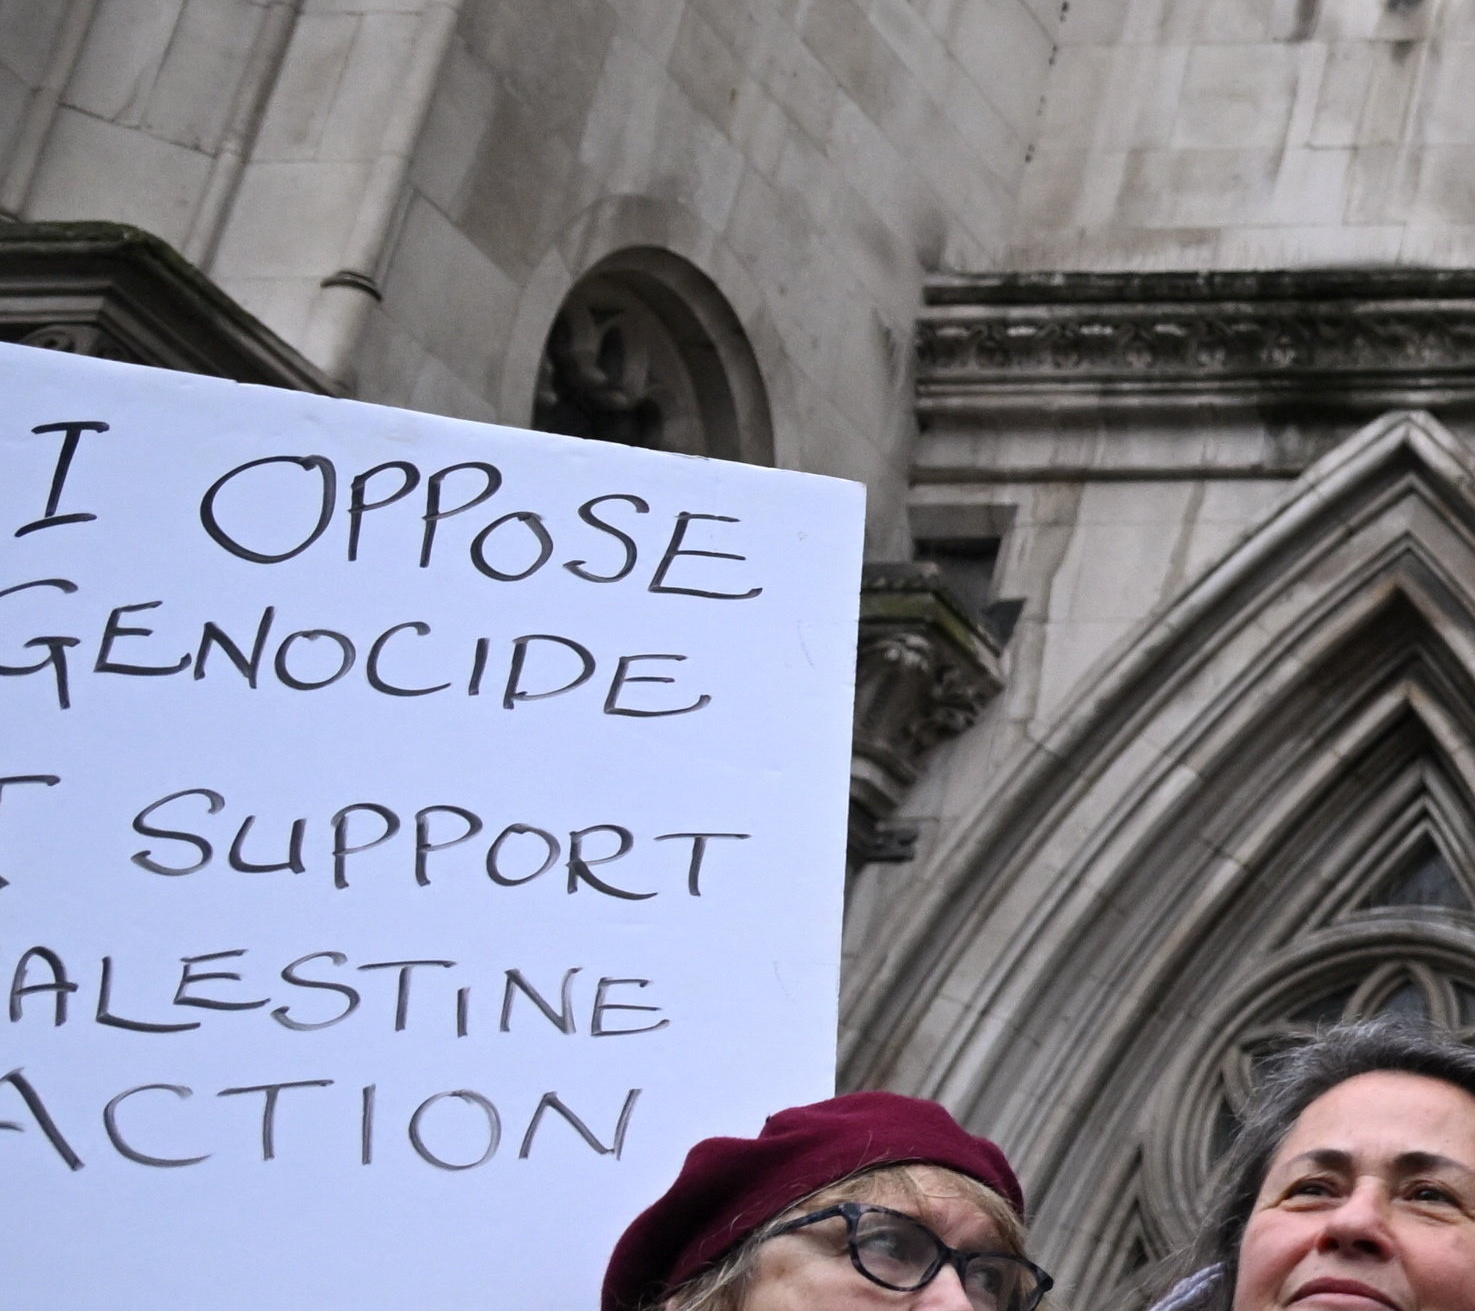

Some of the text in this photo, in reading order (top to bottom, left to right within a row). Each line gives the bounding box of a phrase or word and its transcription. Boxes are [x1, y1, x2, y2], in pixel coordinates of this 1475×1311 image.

[15, 421, 763, 601] I OPPOSE
[131, 789, 751, 899] SUPPORT
